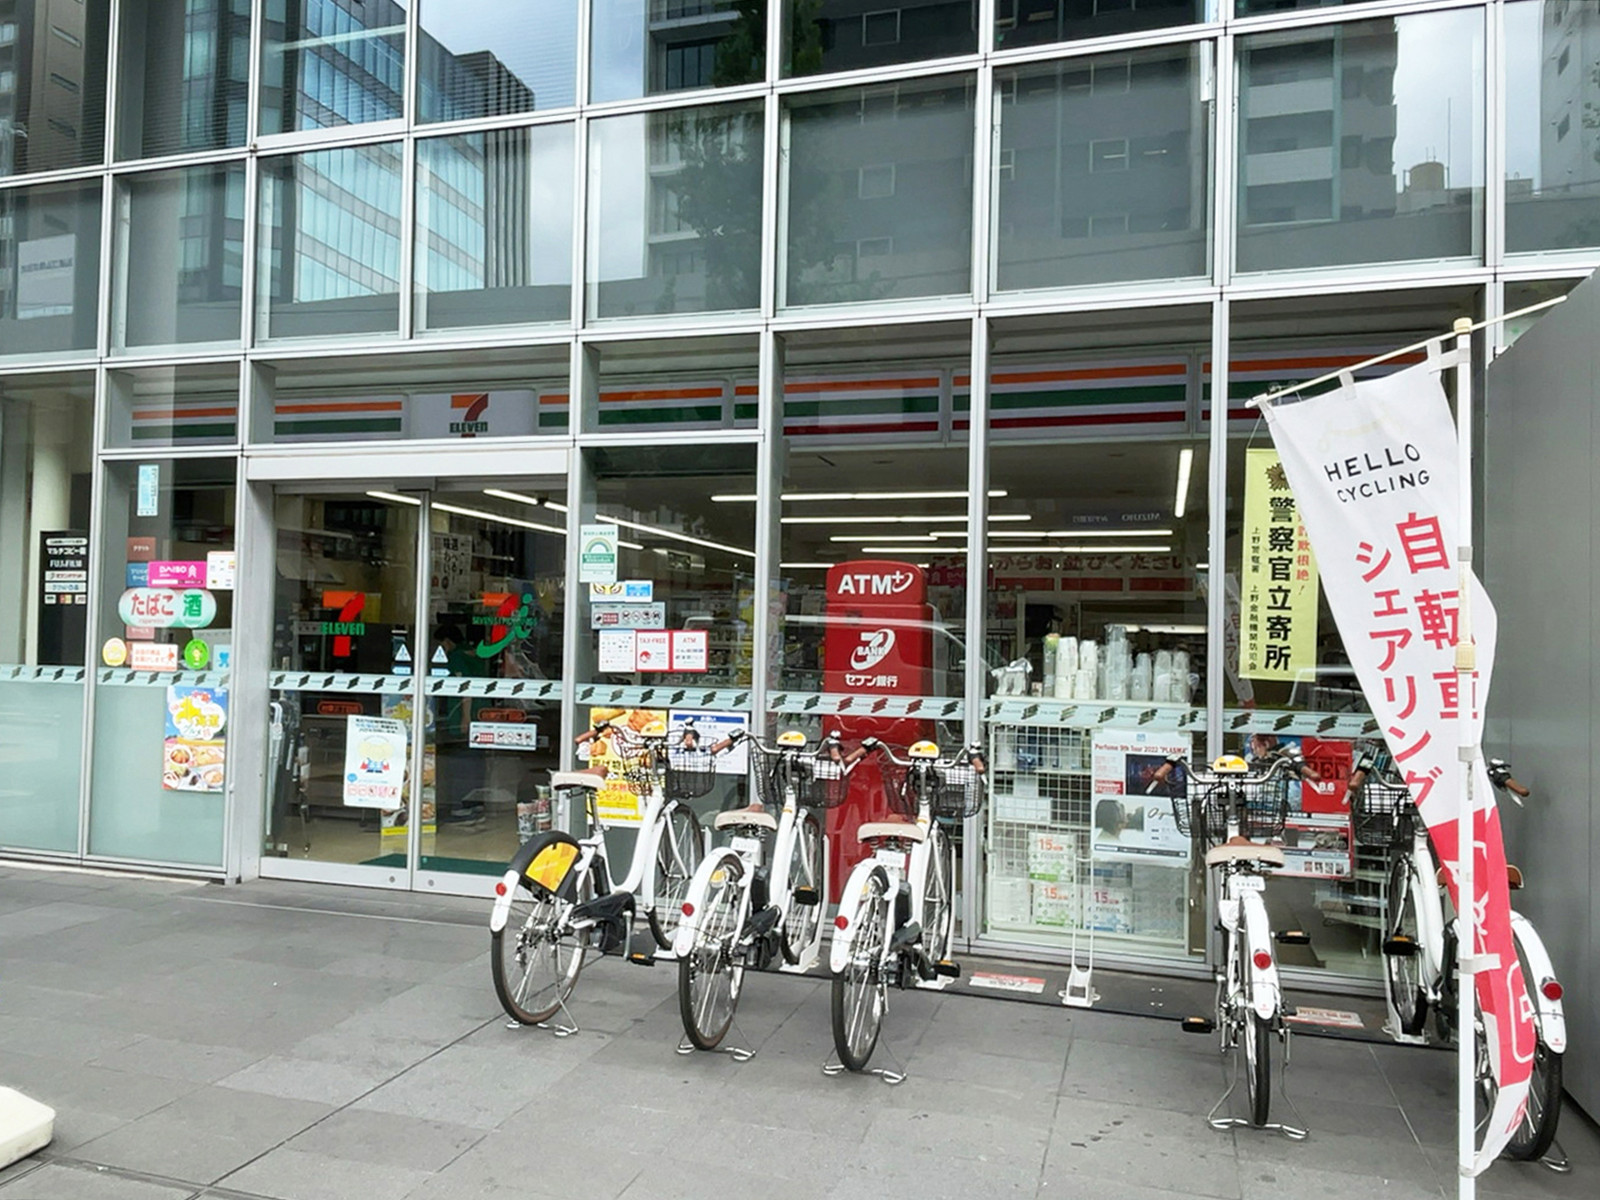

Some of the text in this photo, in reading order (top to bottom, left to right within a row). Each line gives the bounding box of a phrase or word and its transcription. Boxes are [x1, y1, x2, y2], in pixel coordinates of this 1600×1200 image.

[450, 422, 488, 433] ELEVEN
[1324, 443, 1420, 482] HELLO
[1337, 470, 1430, 503] CYCLING
[1264, 497, 1295, 672] 警察官立寄所
[131, 593, 174, 616] たばこ
[183, 593, 203, 617] 酒
[1396, 512, 1479, 719] 自転車
[321, 622, 365, 636] ELEVEN
[845, 673, 898, 688] セブン銀行
[1356, 541, 1443, 808] シェアリング
[1095, 743, 1118, 751] Perfume
[1039, 838, 1054, 851] 15
[1094, 891, 1109, 904] 15
